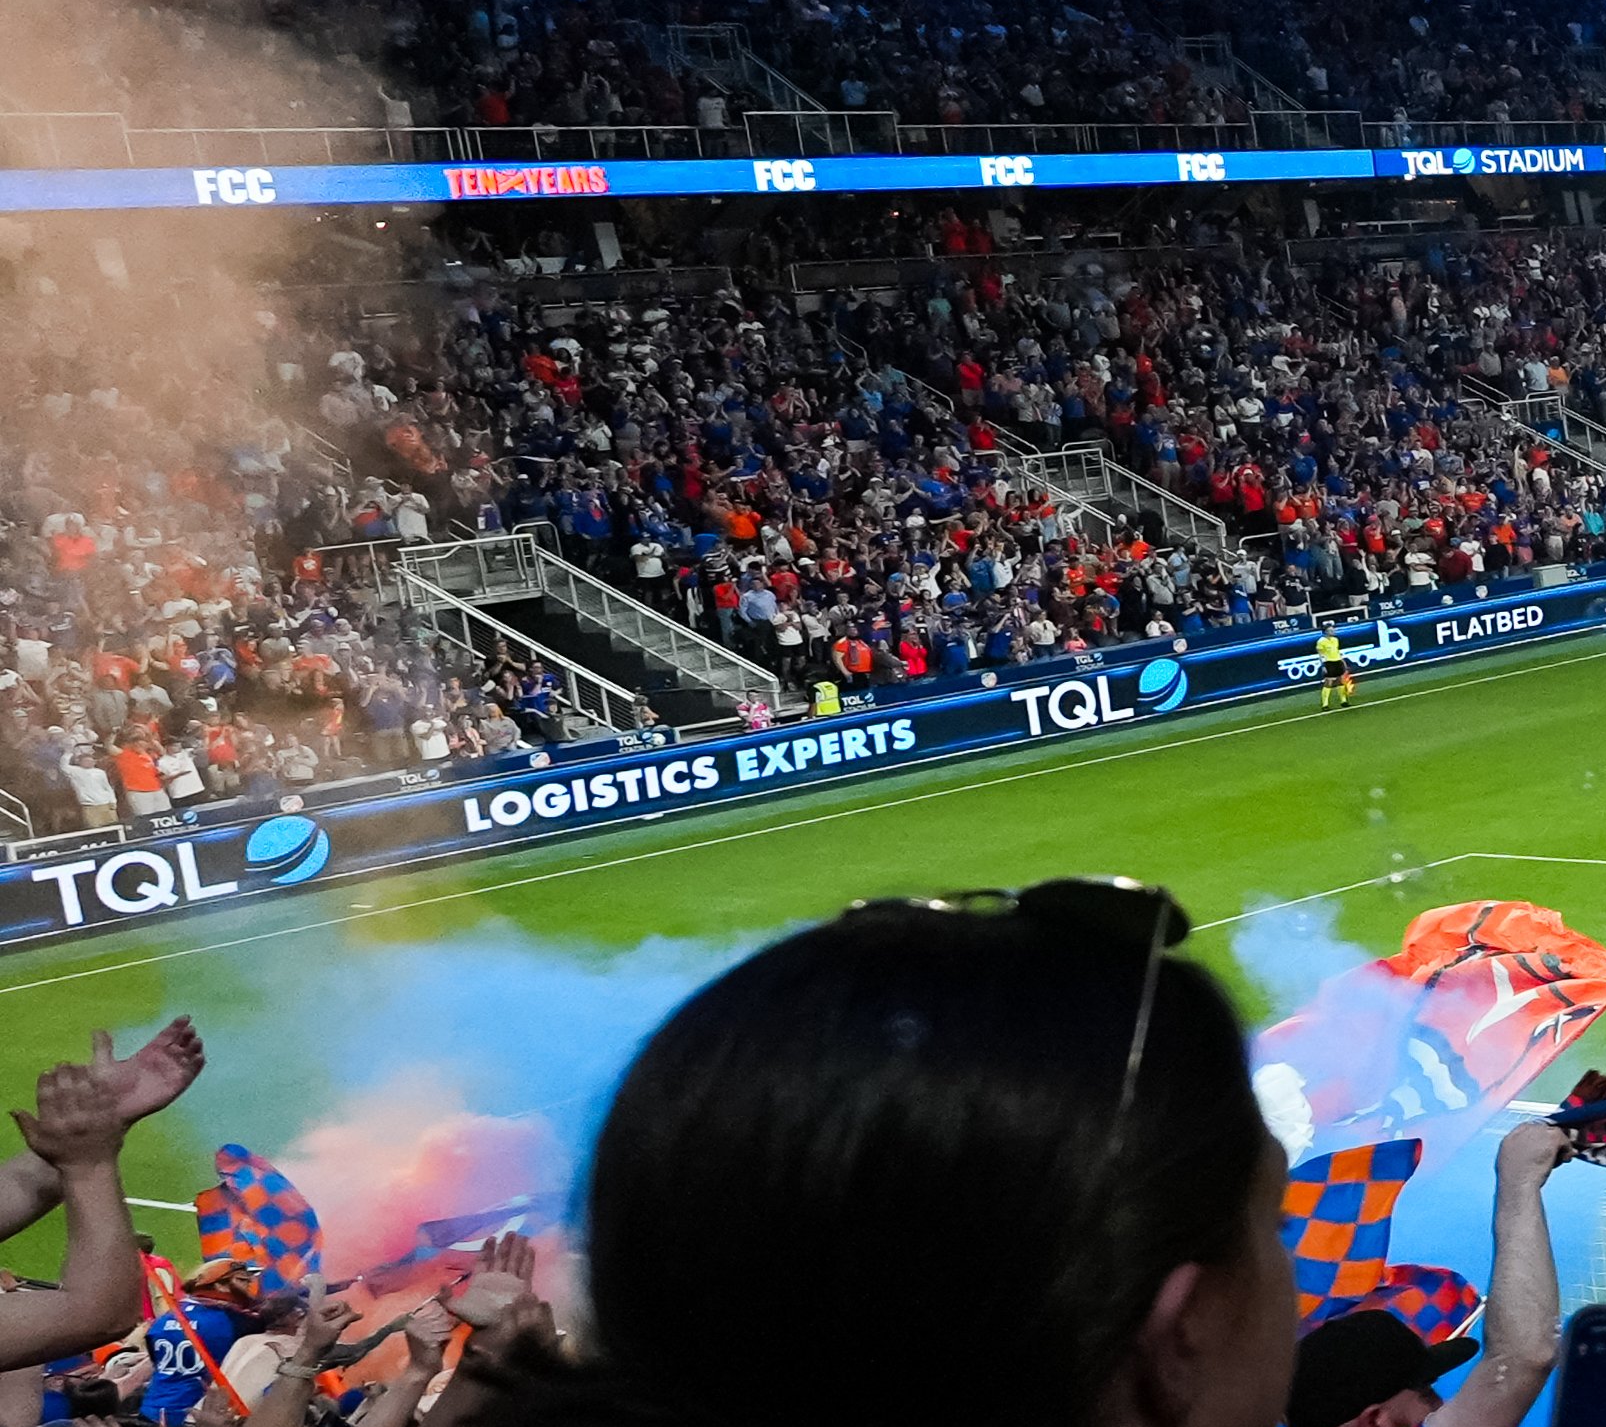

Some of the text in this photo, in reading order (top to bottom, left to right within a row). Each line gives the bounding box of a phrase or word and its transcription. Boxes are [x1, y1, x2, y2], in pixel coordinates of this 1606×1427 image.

[753, 160, 816, 191] FCC
[979, 156, 1034, 186] FCC
[1177, 153, 1226, 181] FCC
[1402, 151, 1453, 175] TQL
[1480, 149, 1585, 173] STADIUM
[193, 168, 276, 204] FCC
[443, 166, 609, 199] TEN YEARS
[1436, 605, 1544, 645] FLATBED
[842, 694, 864, 706] TQL
[1010, 676, 1135, 736] TQL
[618, 735, 642, 746] TQL
[398, 773, 426, 785] TQL
[463, 719, 917, 833] LOGISTICS EXPERTS
[150, 814, 183, 828] TQL
[32, 841, 239, 925] TQL
[154, 1338, 205, 1376] 20
